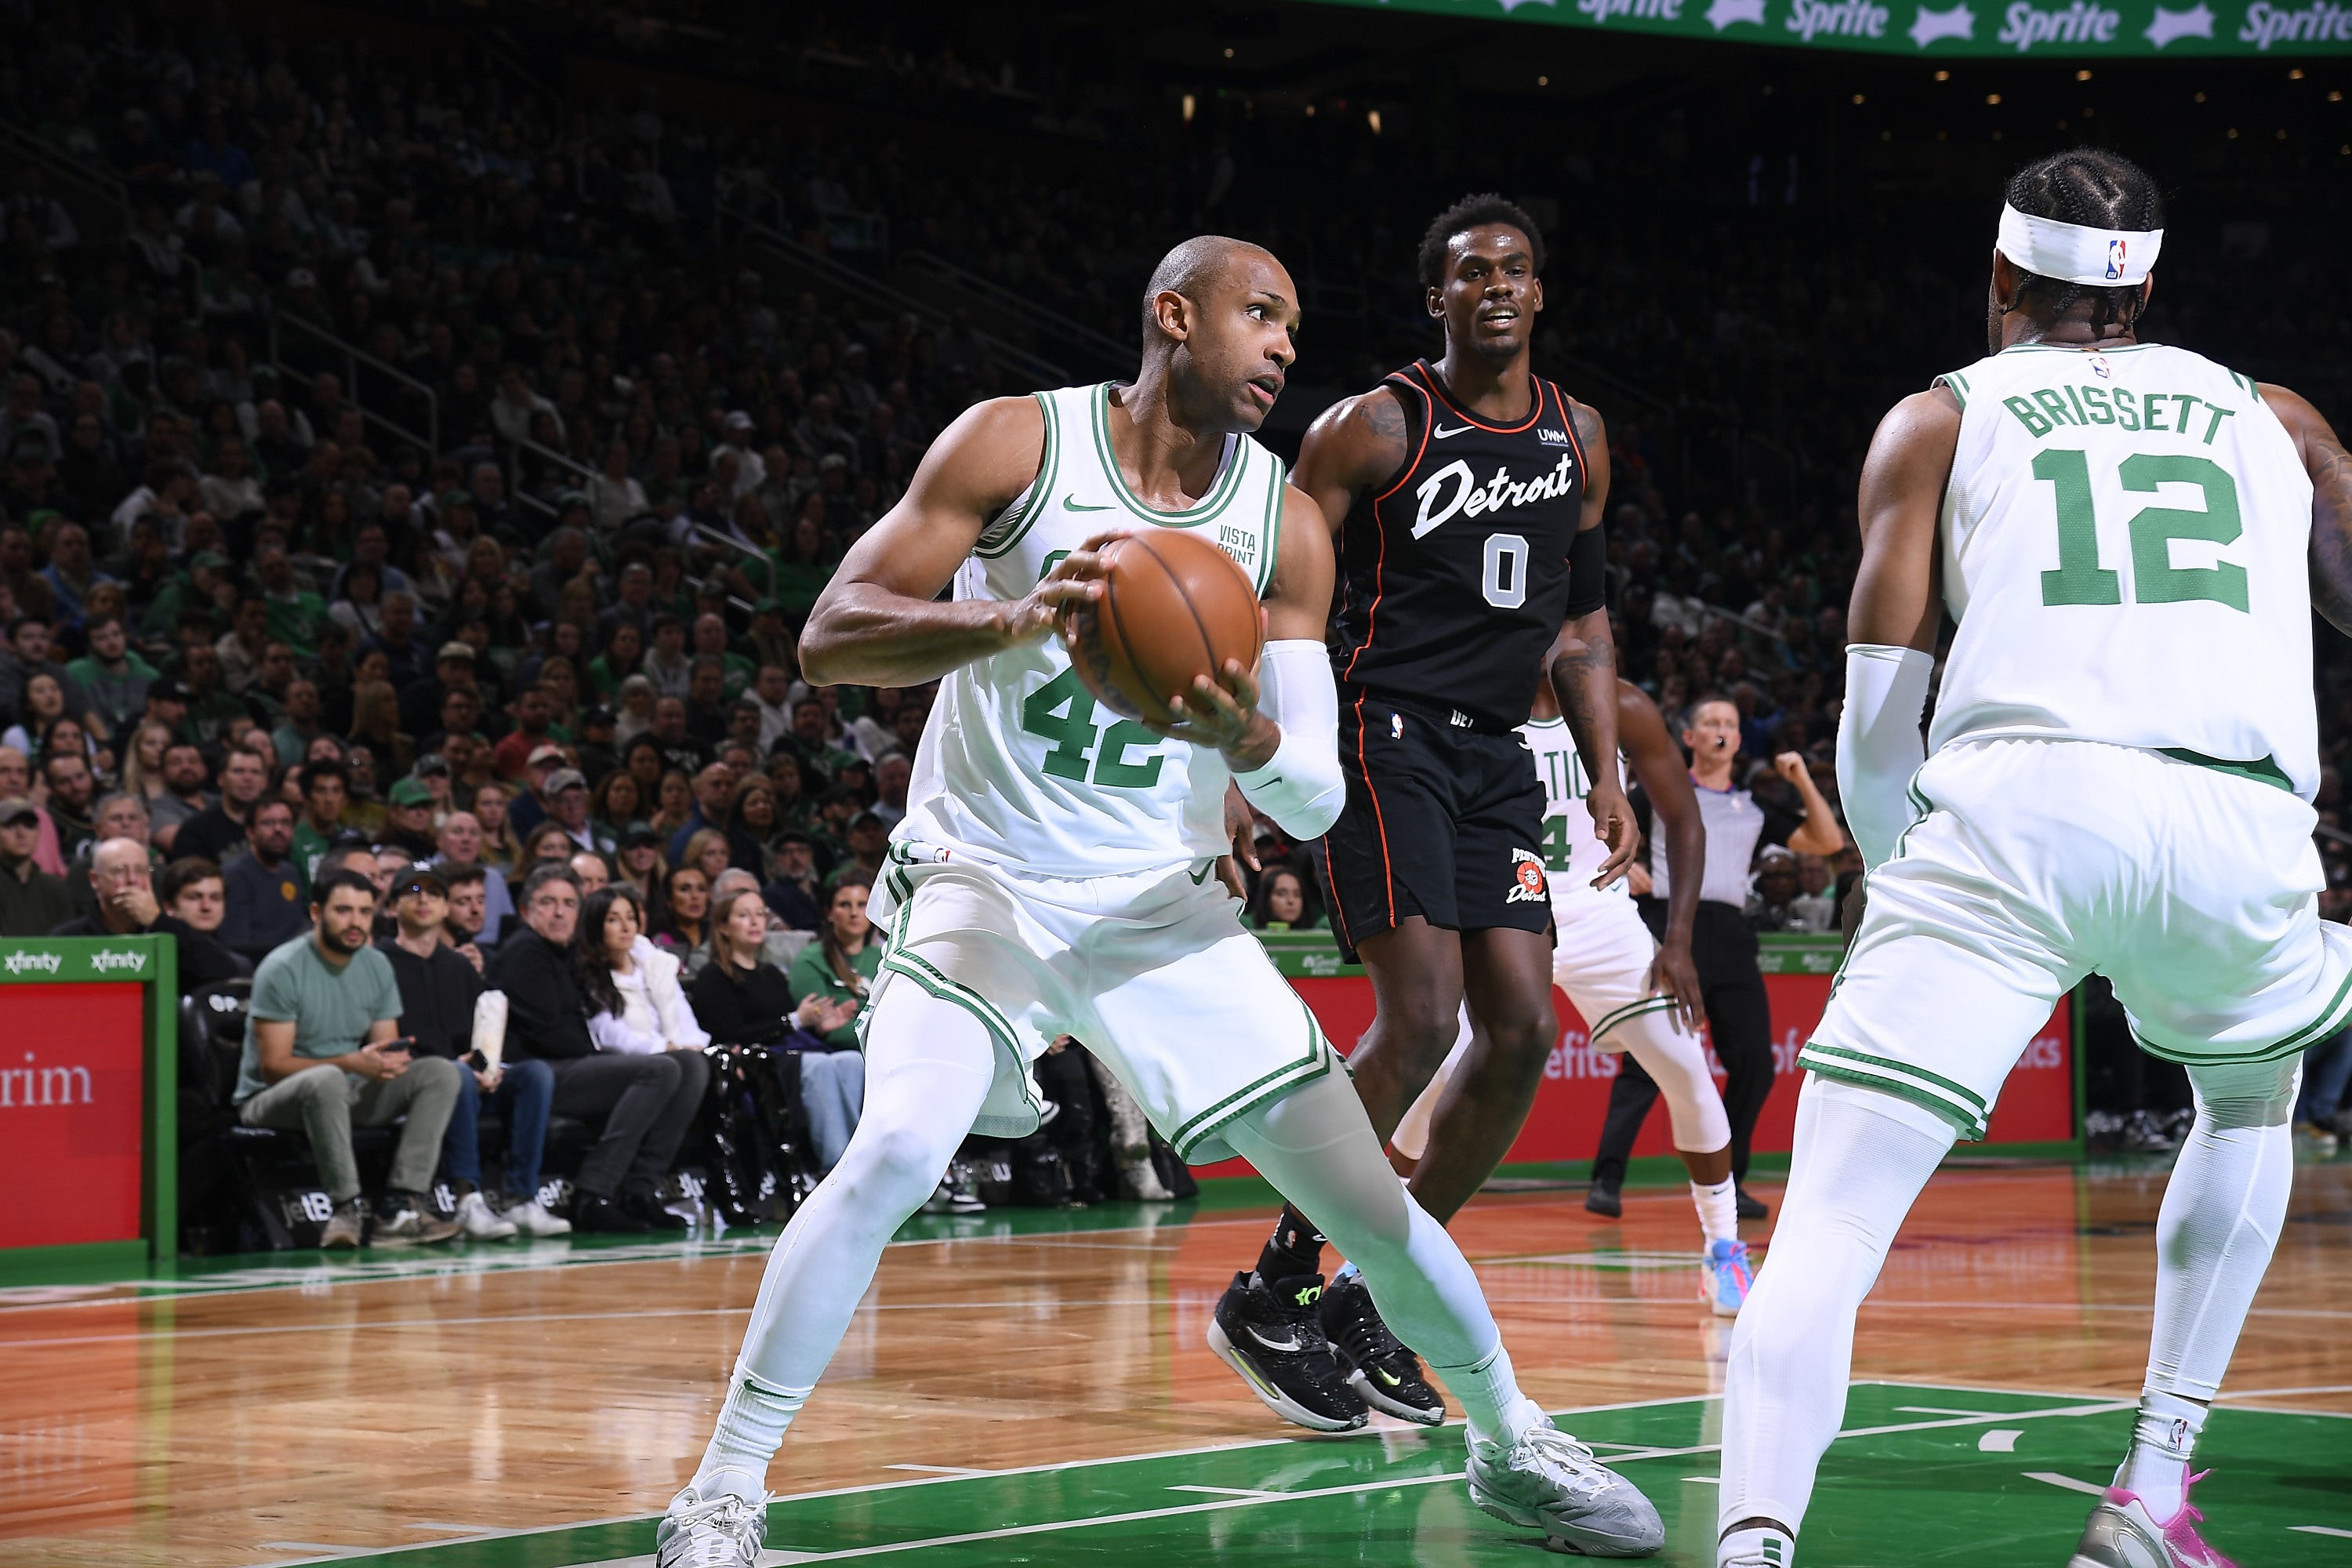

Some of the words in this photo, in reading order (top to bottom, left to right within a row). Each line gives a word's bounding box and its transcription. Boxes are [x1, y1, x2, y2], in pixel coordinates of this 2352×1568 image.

[1786, 0, 1889, 42] Sprite
[1998, 1, 2120, 51] Sprite
[2238, 1, 2352, 49] Sprite
[1537, 428, 1568, 444] UWM
[2002, 385, 2235, 446] BRISSETT
[1410, 453, 1573, 541] Detroit
[1220, 524, 1255, 552] VISTA
[2031, 448, 2250, 615] 12
[1482, 533, 1530, 609] 0
[1022, 663, 1165, 788] 42
[4, 950, 63, 975] xfinity
[91, 949, 147, 973] xfinity
